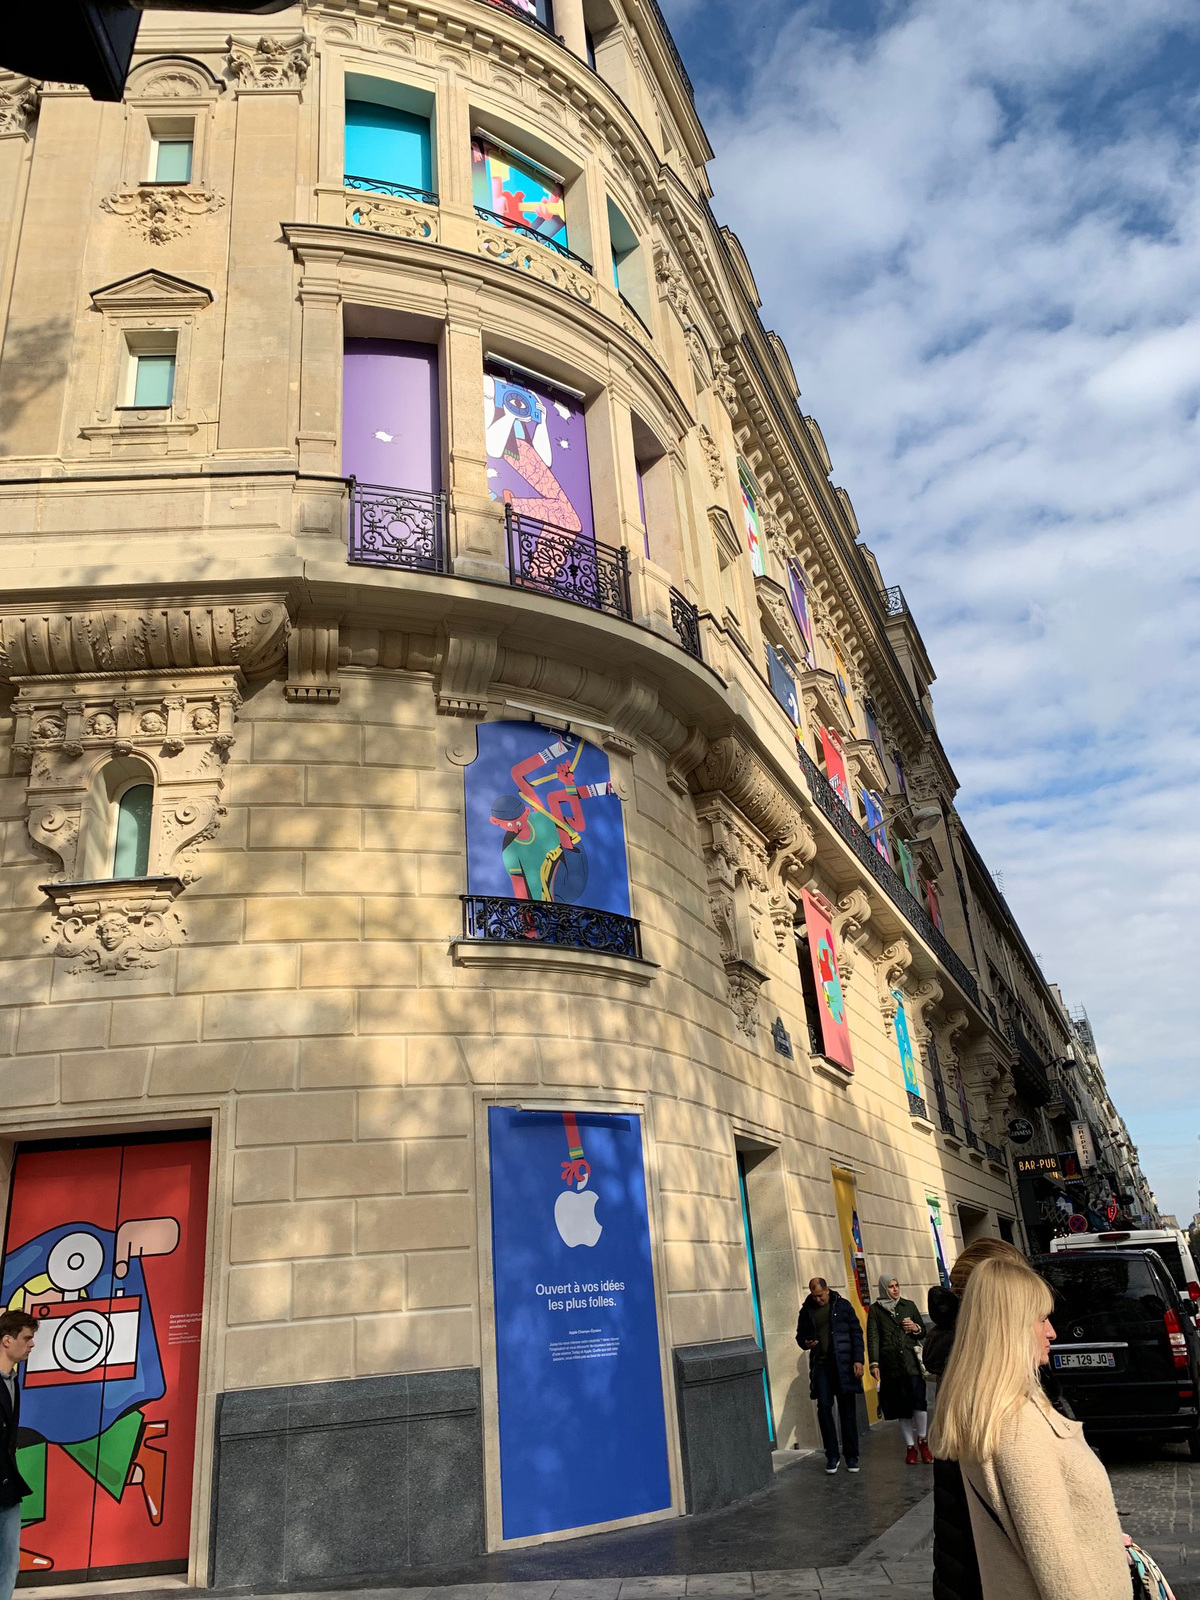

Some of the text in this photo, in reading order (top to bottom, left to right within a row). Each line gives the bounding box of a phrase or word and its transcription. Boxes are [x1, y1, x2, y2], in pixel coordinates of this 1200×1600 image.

[1018, 1158, 1056, 1170] BAR-PUB
[535, 1280, 625, 1296] Ouvert à vos idées
[548, 1295, 617, 1312] les plus folles.
